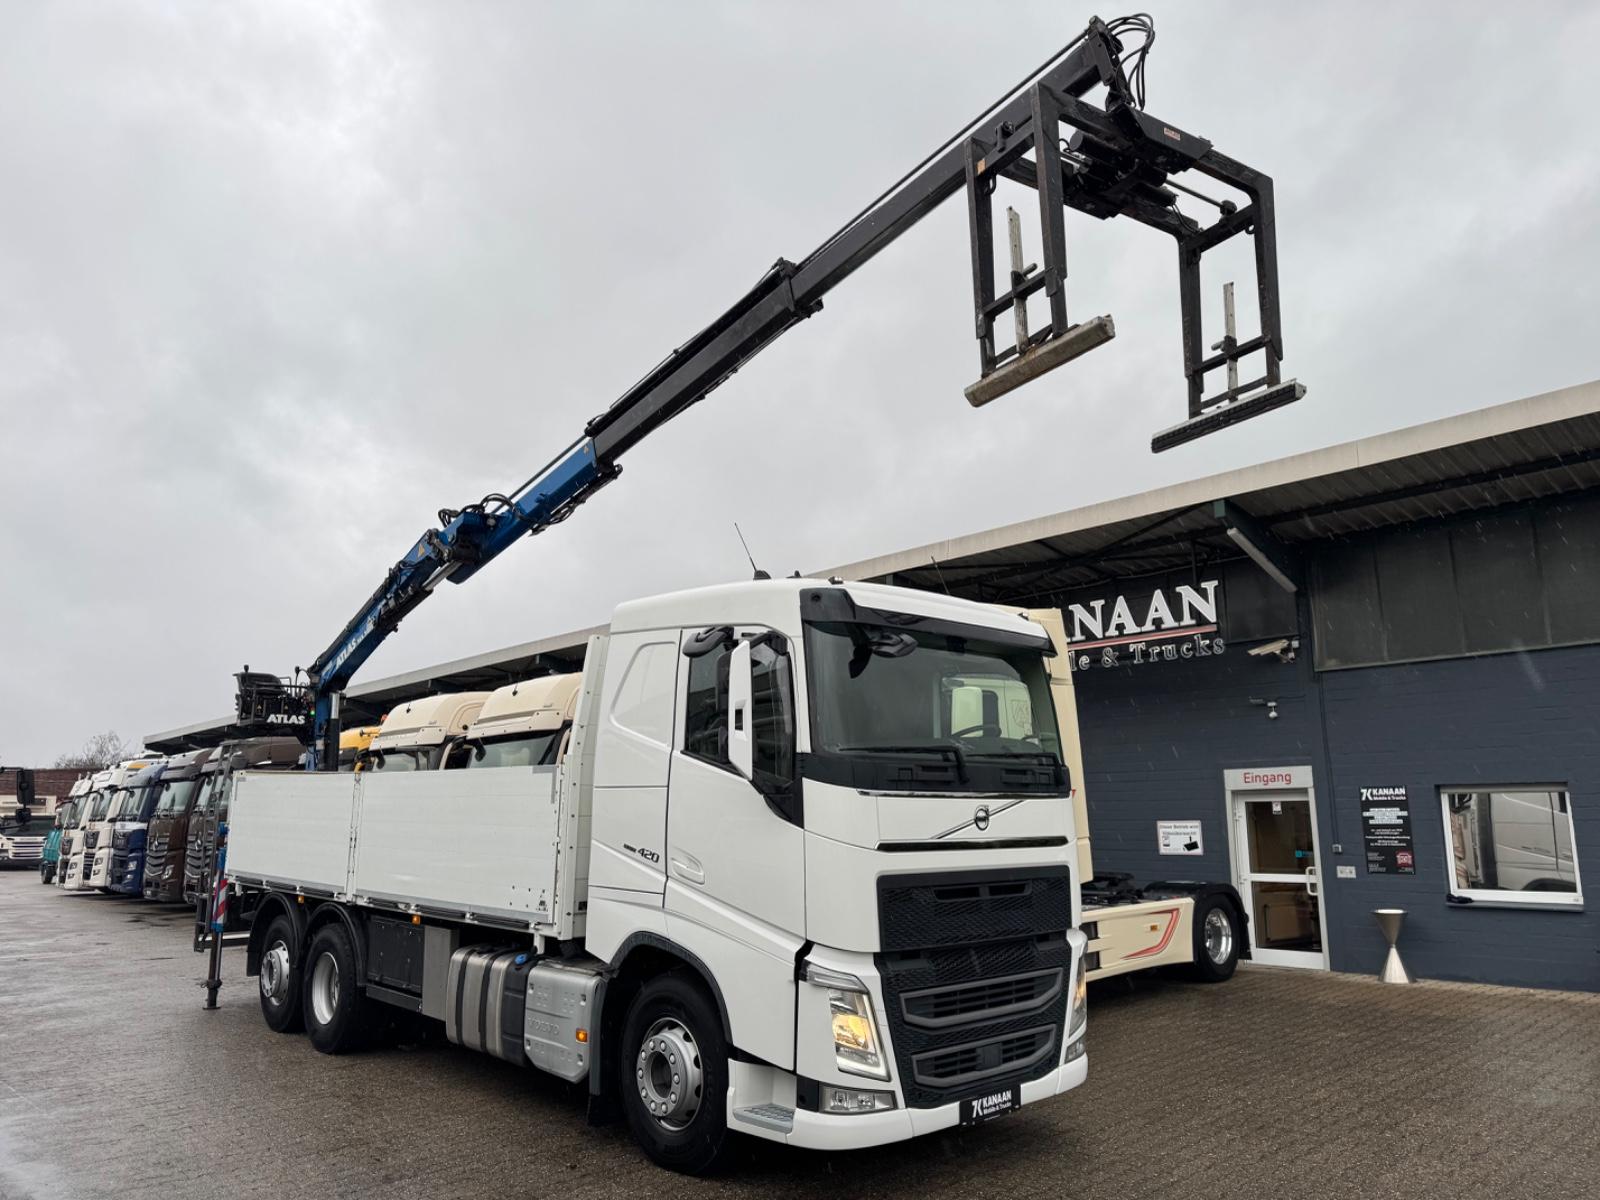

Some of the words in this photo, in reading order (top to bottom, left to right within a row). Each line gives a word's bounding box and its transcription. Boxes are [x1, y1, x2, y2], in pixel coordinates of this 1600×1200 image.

[1101, 646, 1119, 668] &
[1129, 635, 1226, 665] Trucks
[266, 713, 306, 725] ATLAS
[1243, 772, 1292, 786] Eingang
[1372, 787, 1406, 796] KANAAN
[637, 848, 660, 863] 420
[982, 1089, 1012, 1108] KANAAN
